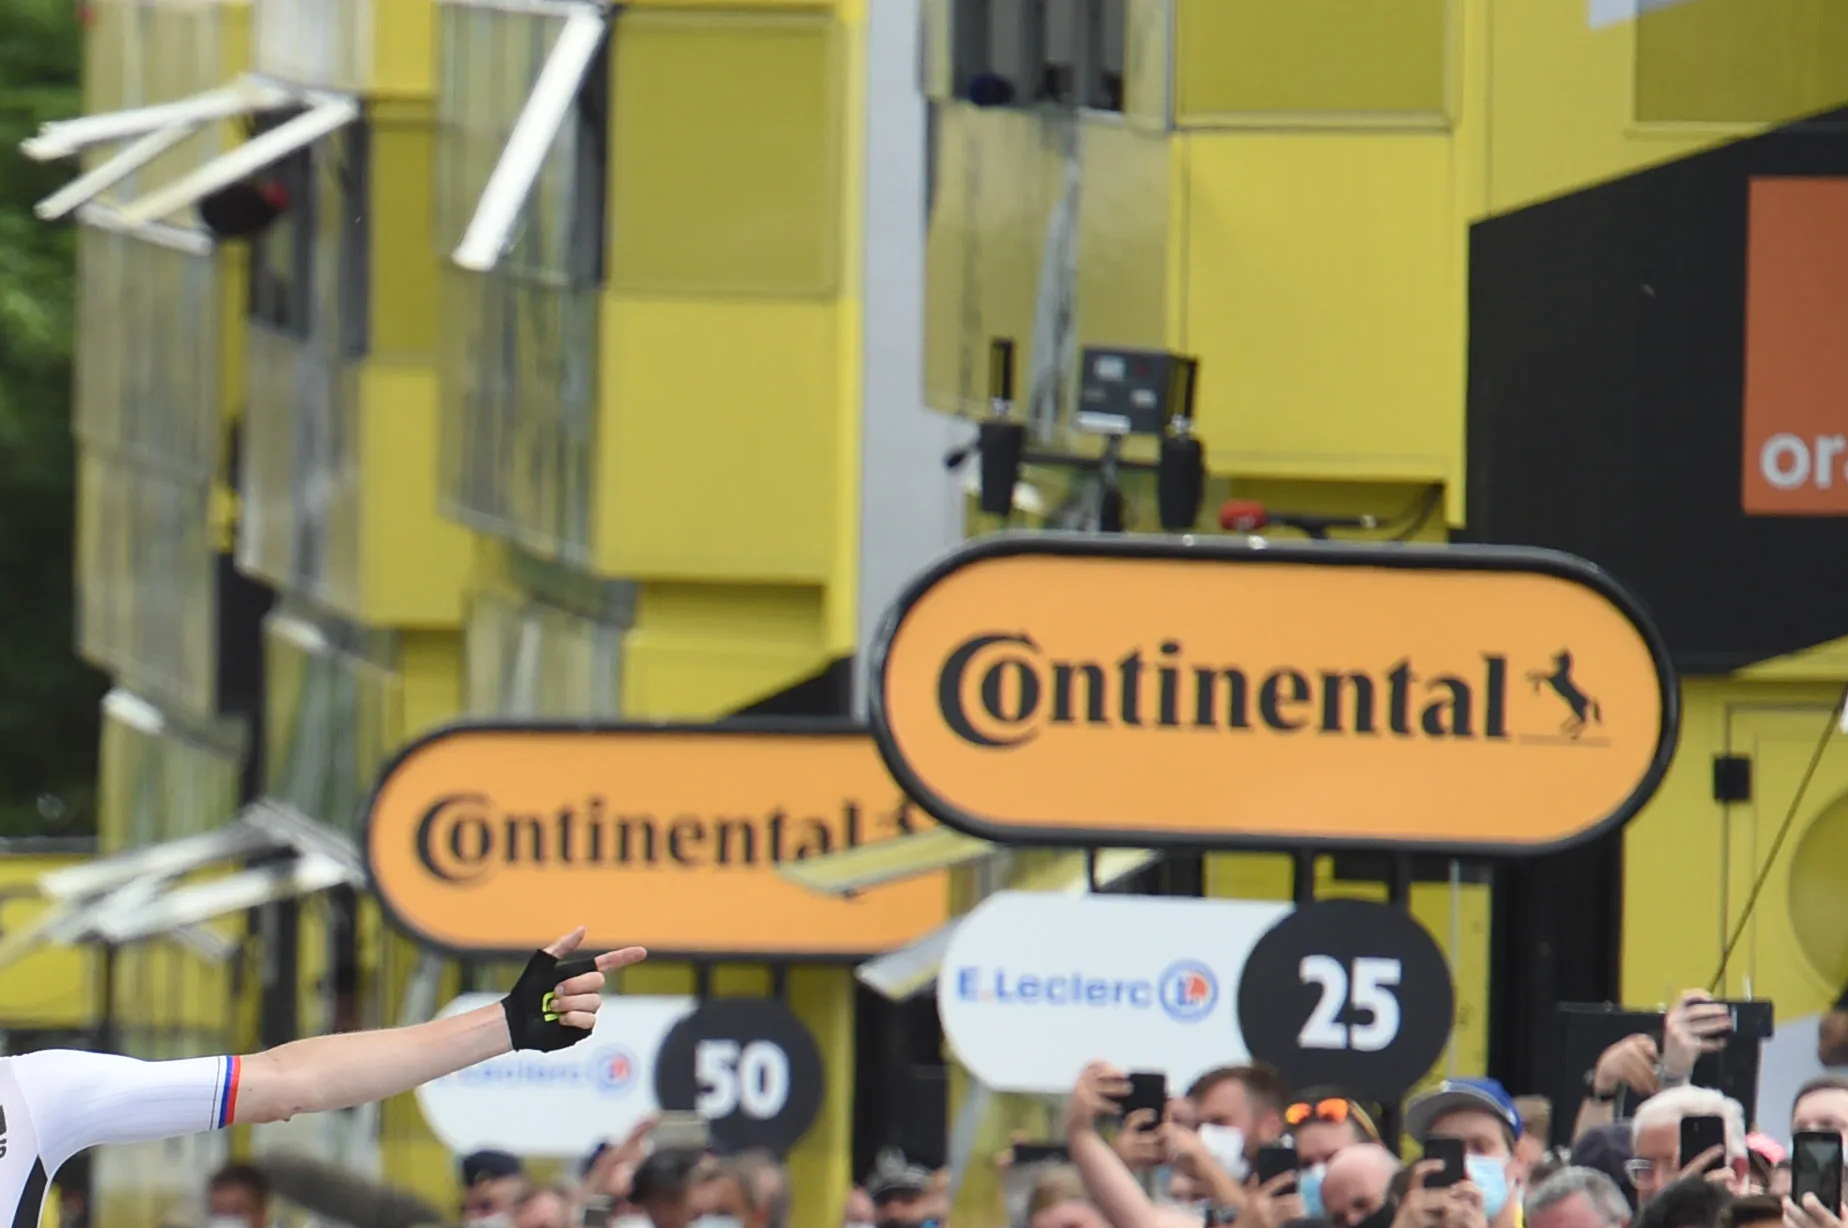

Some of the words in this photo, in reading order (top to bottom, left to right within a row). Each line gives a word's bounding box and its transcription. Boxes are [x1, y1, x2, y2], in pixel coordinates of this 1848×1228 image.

[1759, 433, 1848, 490] or
[937, 631, 1511, 749] Continental
[1298, 954, 1402, 1052] 25
[694, 1039, 790, 1120] 50
